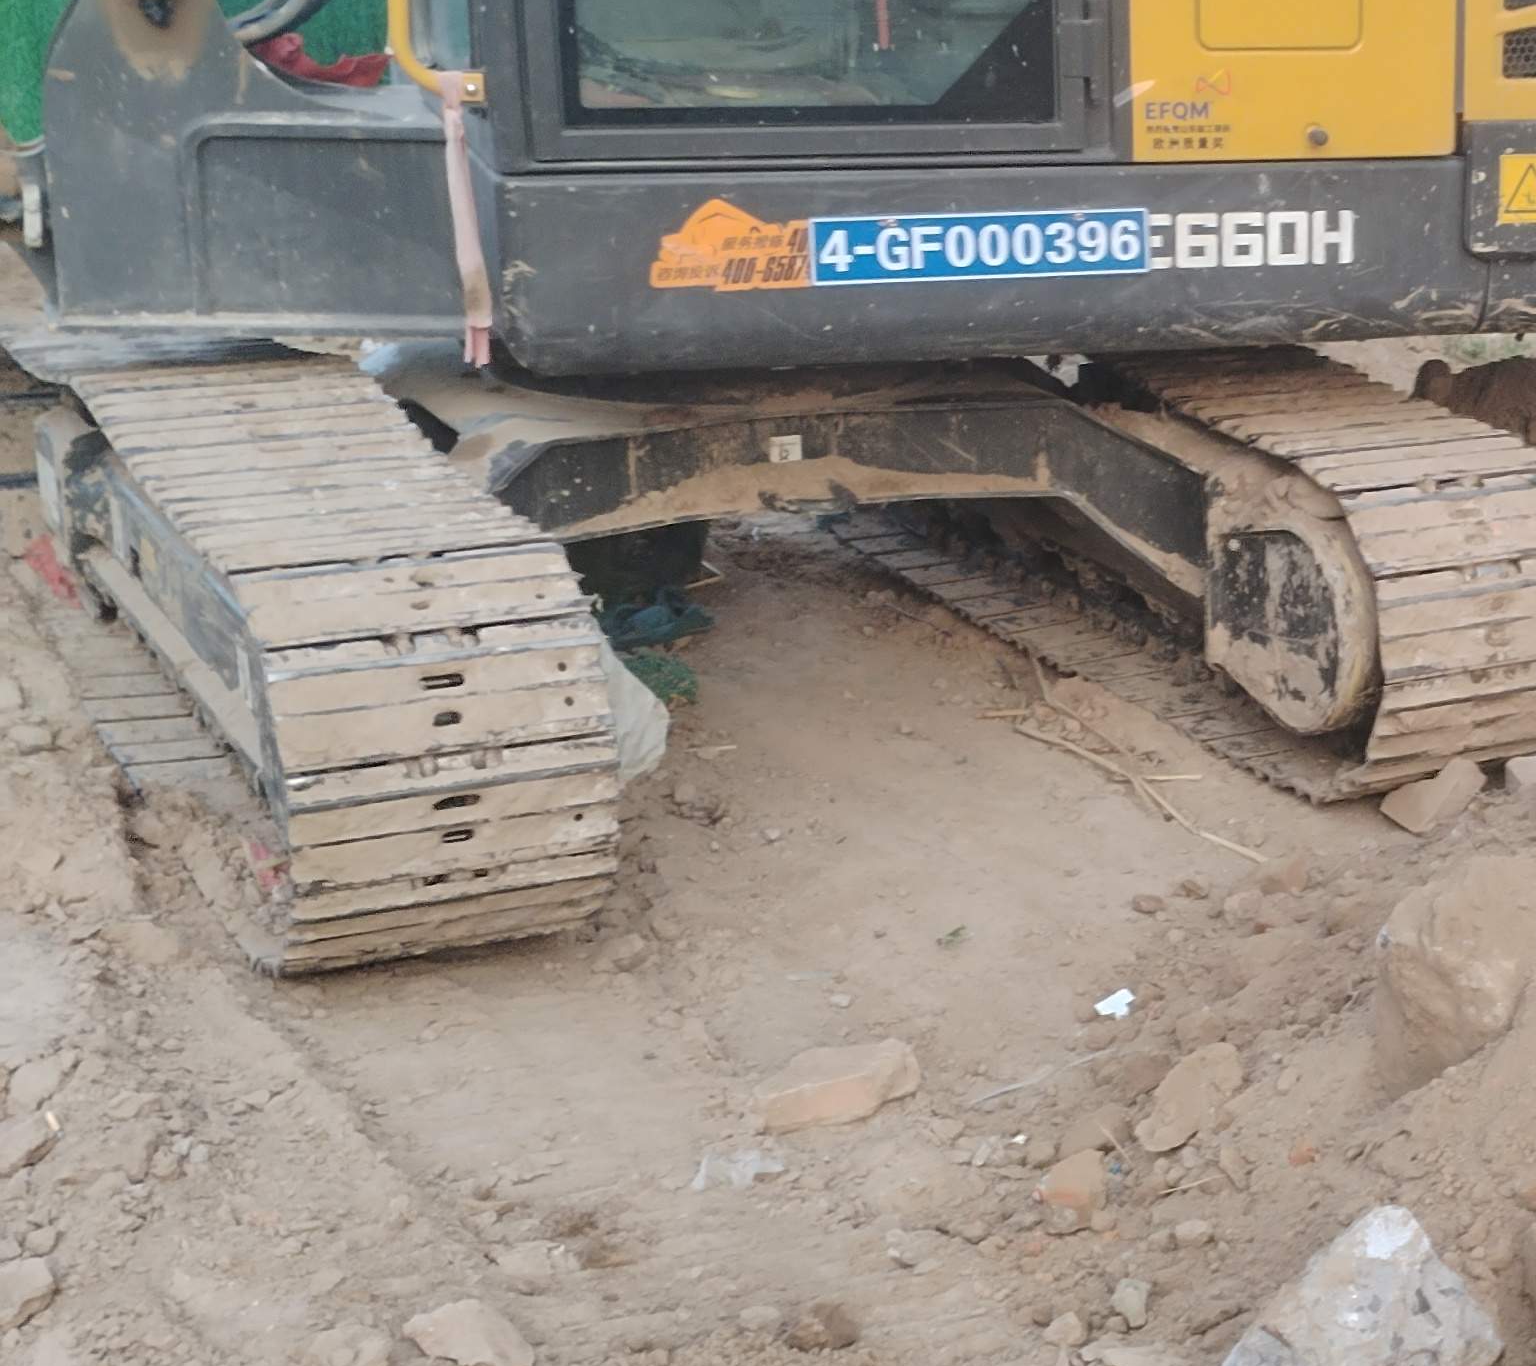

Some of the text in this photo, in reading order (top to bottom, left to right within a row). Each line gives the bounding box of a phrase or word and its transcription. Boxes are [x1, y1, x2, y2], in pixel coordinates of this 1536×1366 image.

[1145, 101, 1209, 121] EFQM
[818, 219, 1141, 272] 4-GF000396
[722, 254, 811, 284] 400-6587
